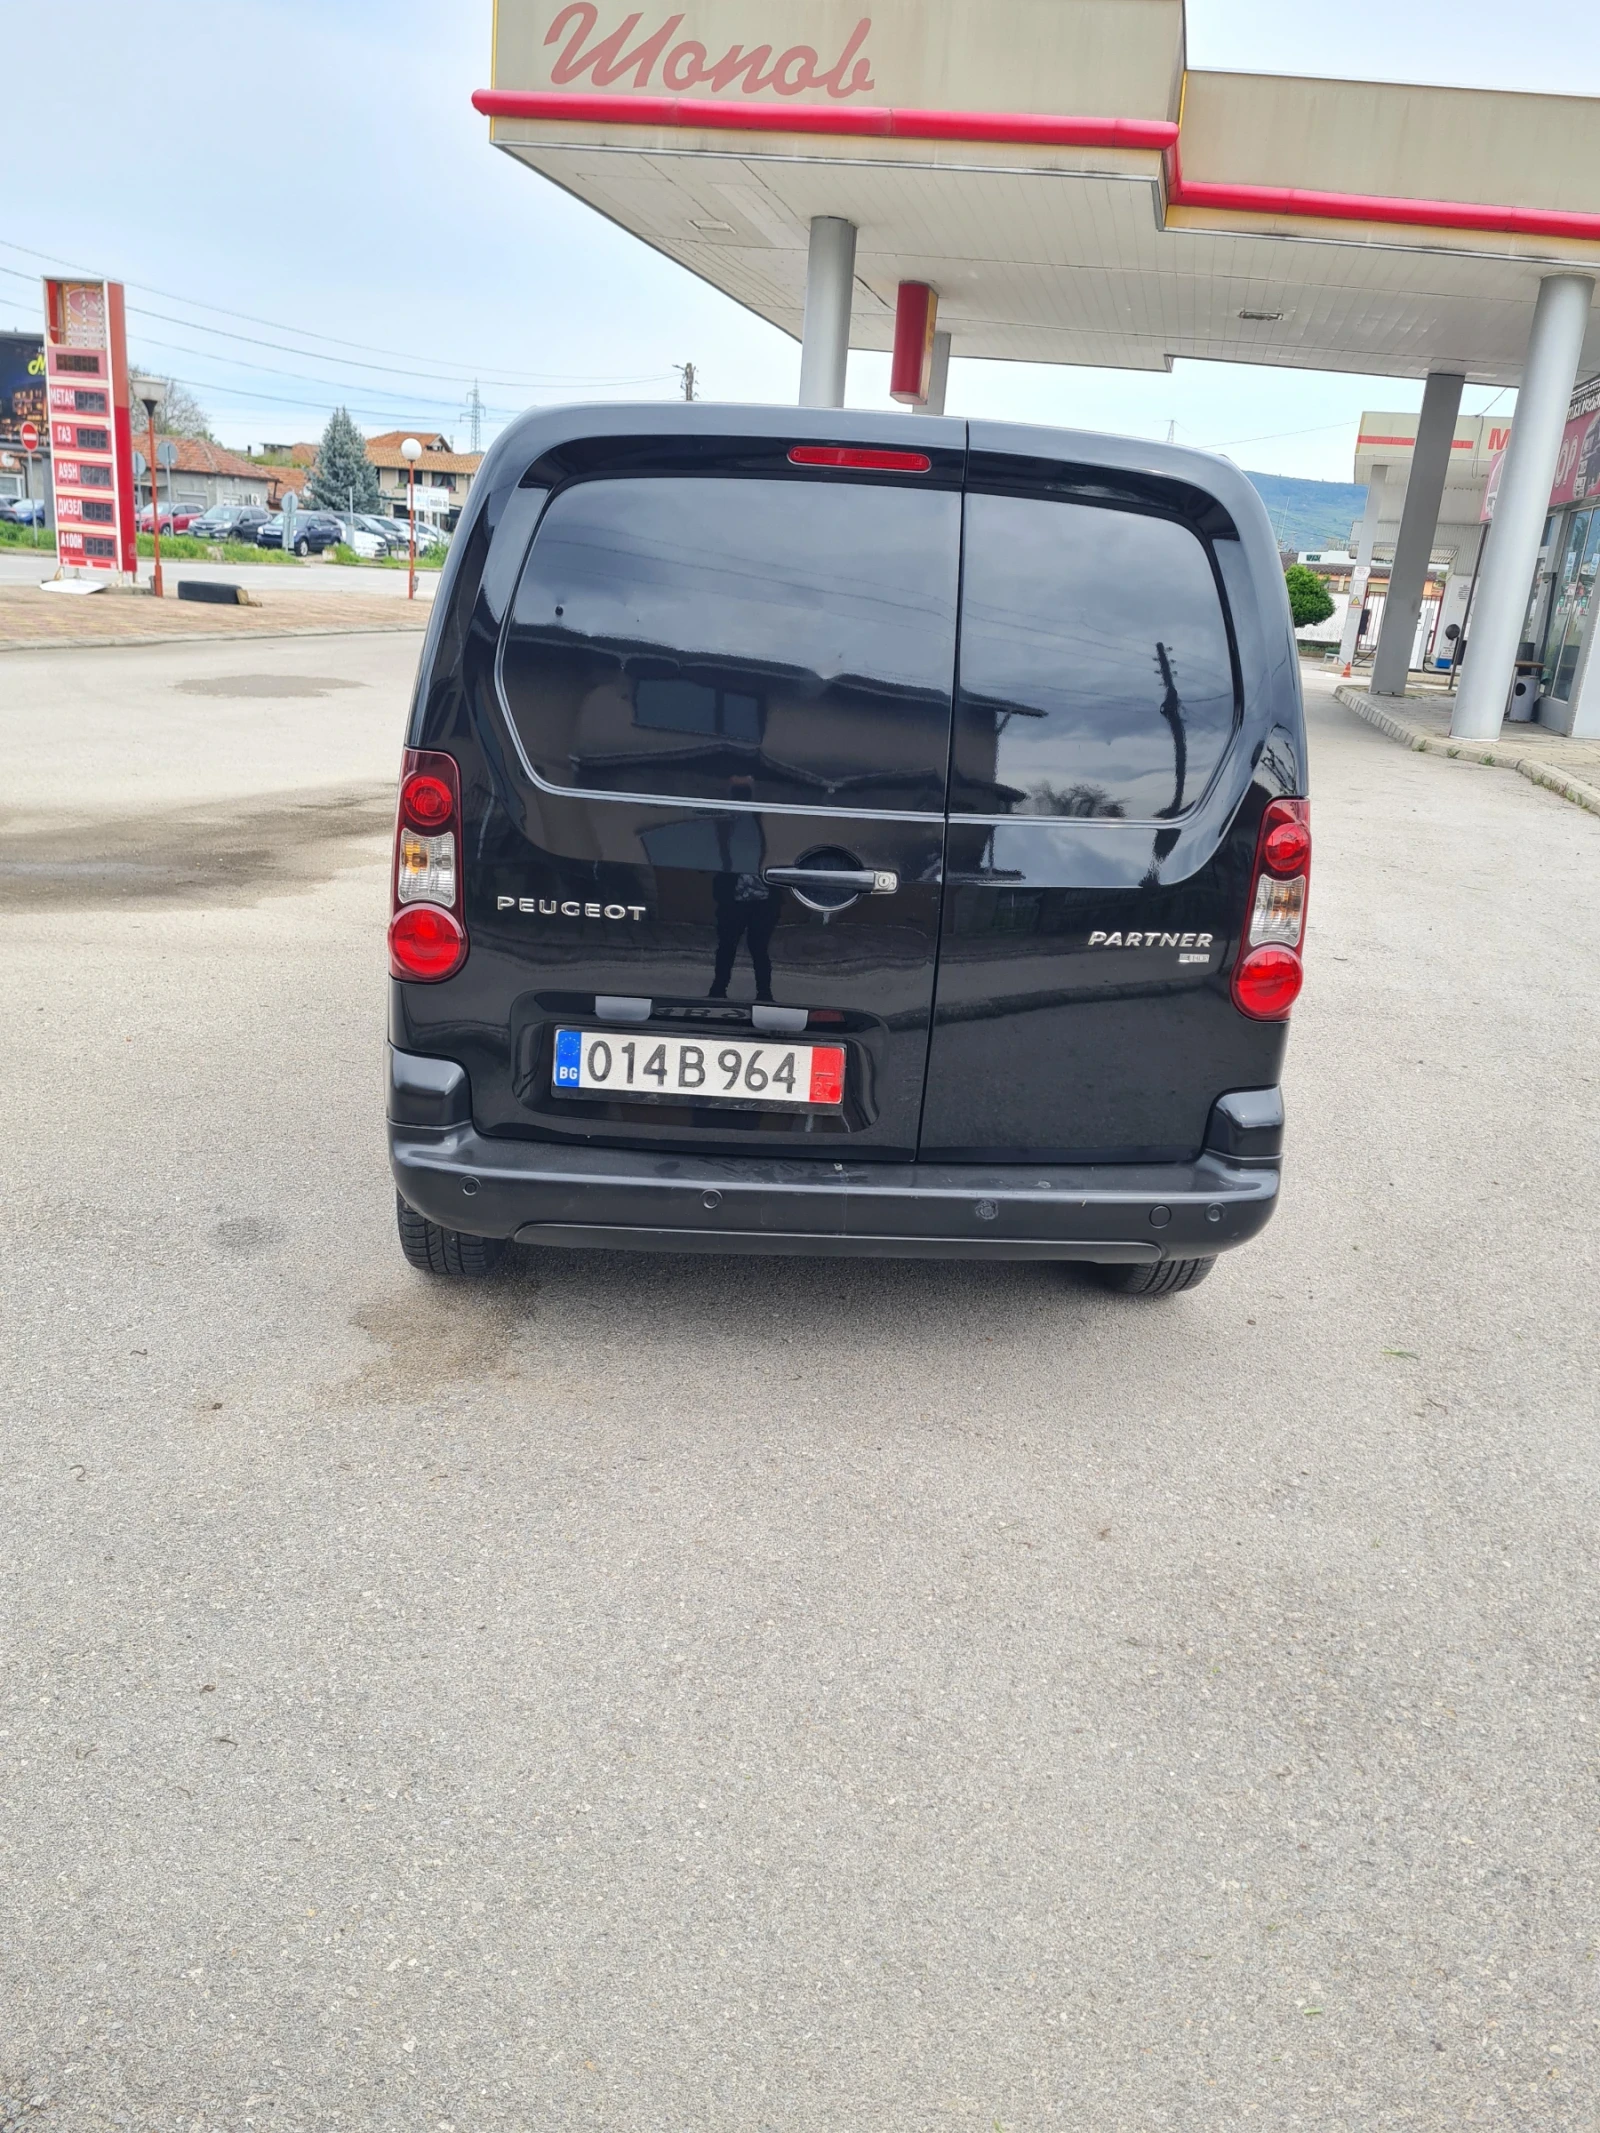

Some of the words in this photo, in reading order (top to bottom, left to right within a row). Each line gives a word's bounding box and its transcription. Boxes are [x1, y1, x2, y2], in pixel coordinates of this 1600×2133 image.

[50, 388, 75, 405] МЕТАН
[57, 425, 72, 443] ГАЗ
[58, 498, 82, 517] ДИЗЕЛ
[497, 896, 647, 921] PEUGEOT
[1088, 931, 1214, 948] PARTNER
[559, 1066, 578, 1080] BG
[586, 1040, 797, 1094] 014B964
